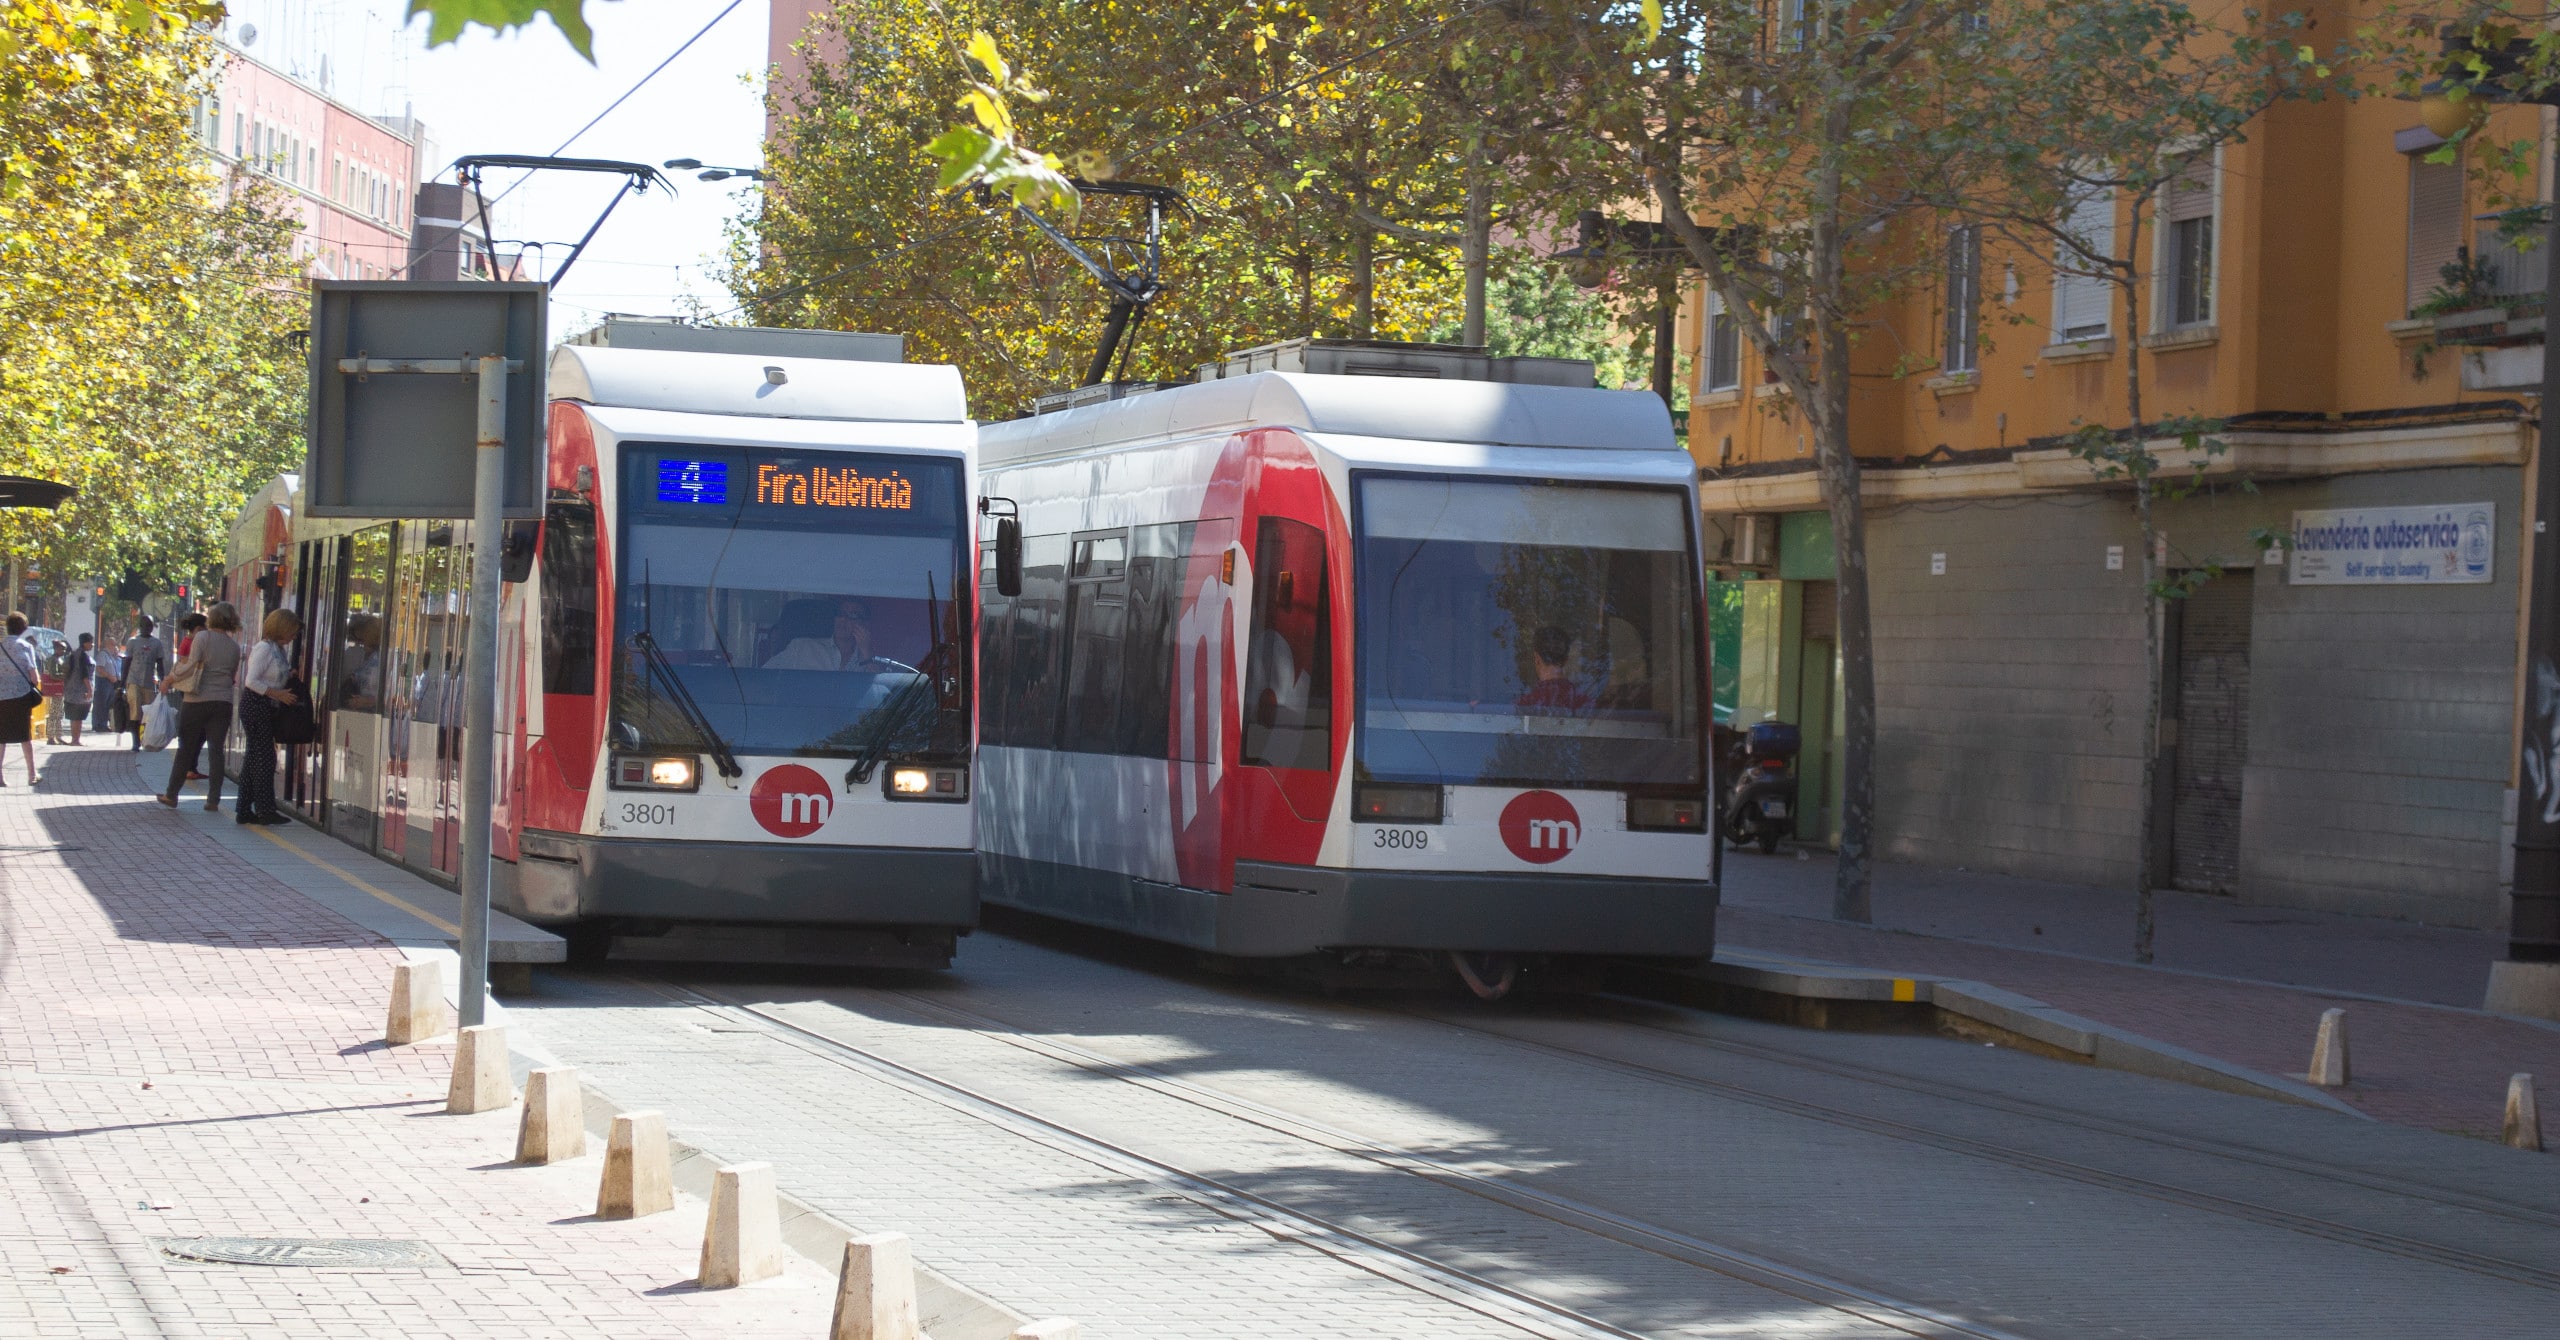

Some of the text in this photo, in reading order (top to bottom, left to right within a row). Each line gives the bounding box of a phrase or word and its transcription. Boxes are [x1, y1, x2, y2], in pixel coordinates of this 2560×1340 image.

[681, 462, 703, 503] 4
[757, 464, 912, 509] Fira València
[2295, 511, 2460, 551] Lavandería autoservicio
[2346, 561, 2363, 577] Self
[2365, 562, 2396, 577] service
[2400, 560, 2431, 580] laundry
[621, 803, 675, 826] 3801
[781, 792, 829, 824] m
[1374, 828, 1428, 850] 3809
[1530, 819, 1577, 849] m
